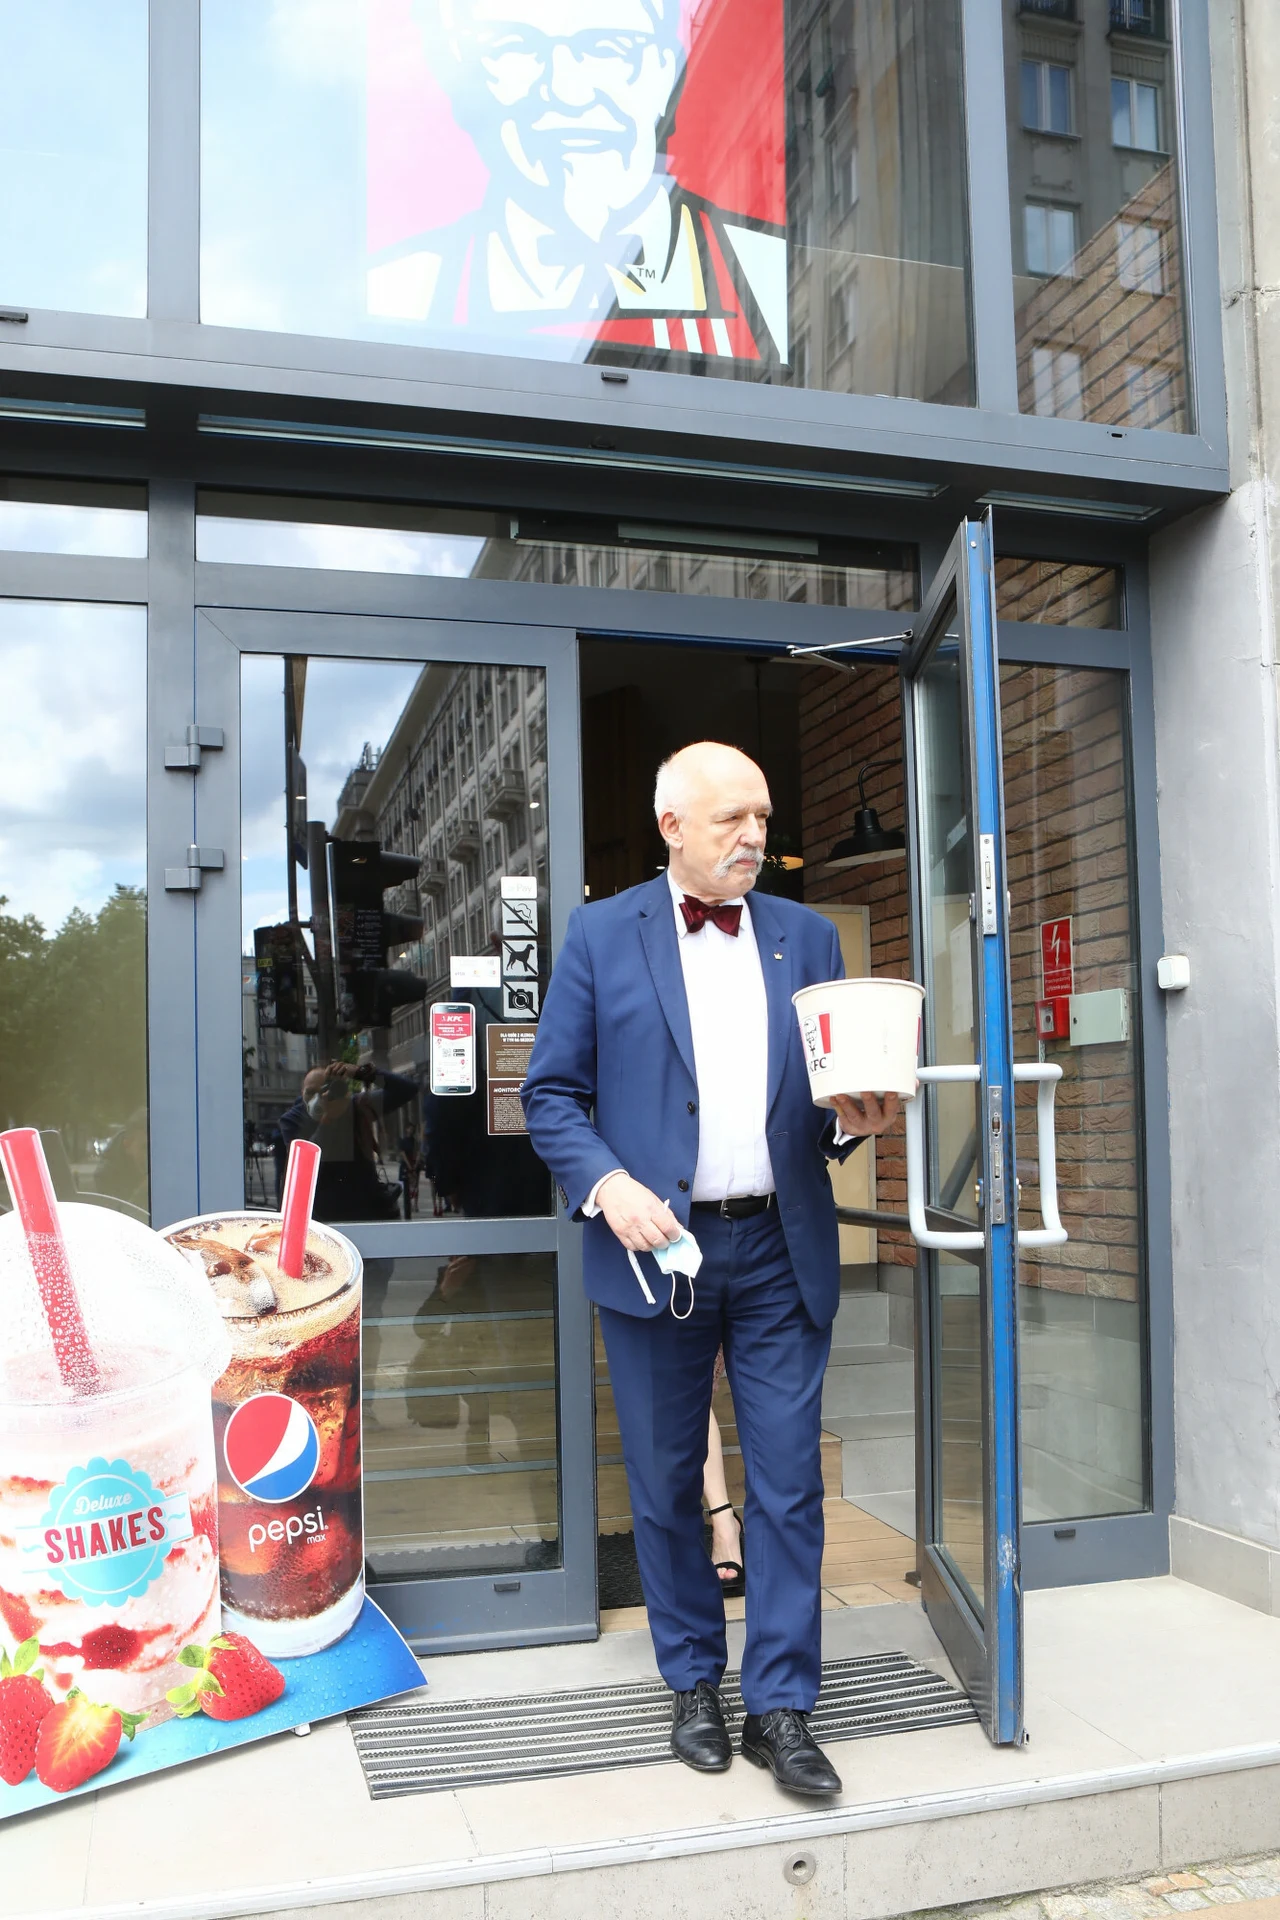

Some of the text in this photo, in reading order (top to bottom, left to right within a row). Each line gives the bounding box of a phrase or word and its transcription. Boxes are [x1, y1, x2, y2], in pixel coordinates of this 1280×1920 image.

[636, 267, 656, 279] TM
[73, 1492, 133, 1515] Deluxe
[44, 1506, 166, 1564] SHAKES
[248, 1505, 325, 1553] pepsi
[306, 1533, 327, 1545] max
